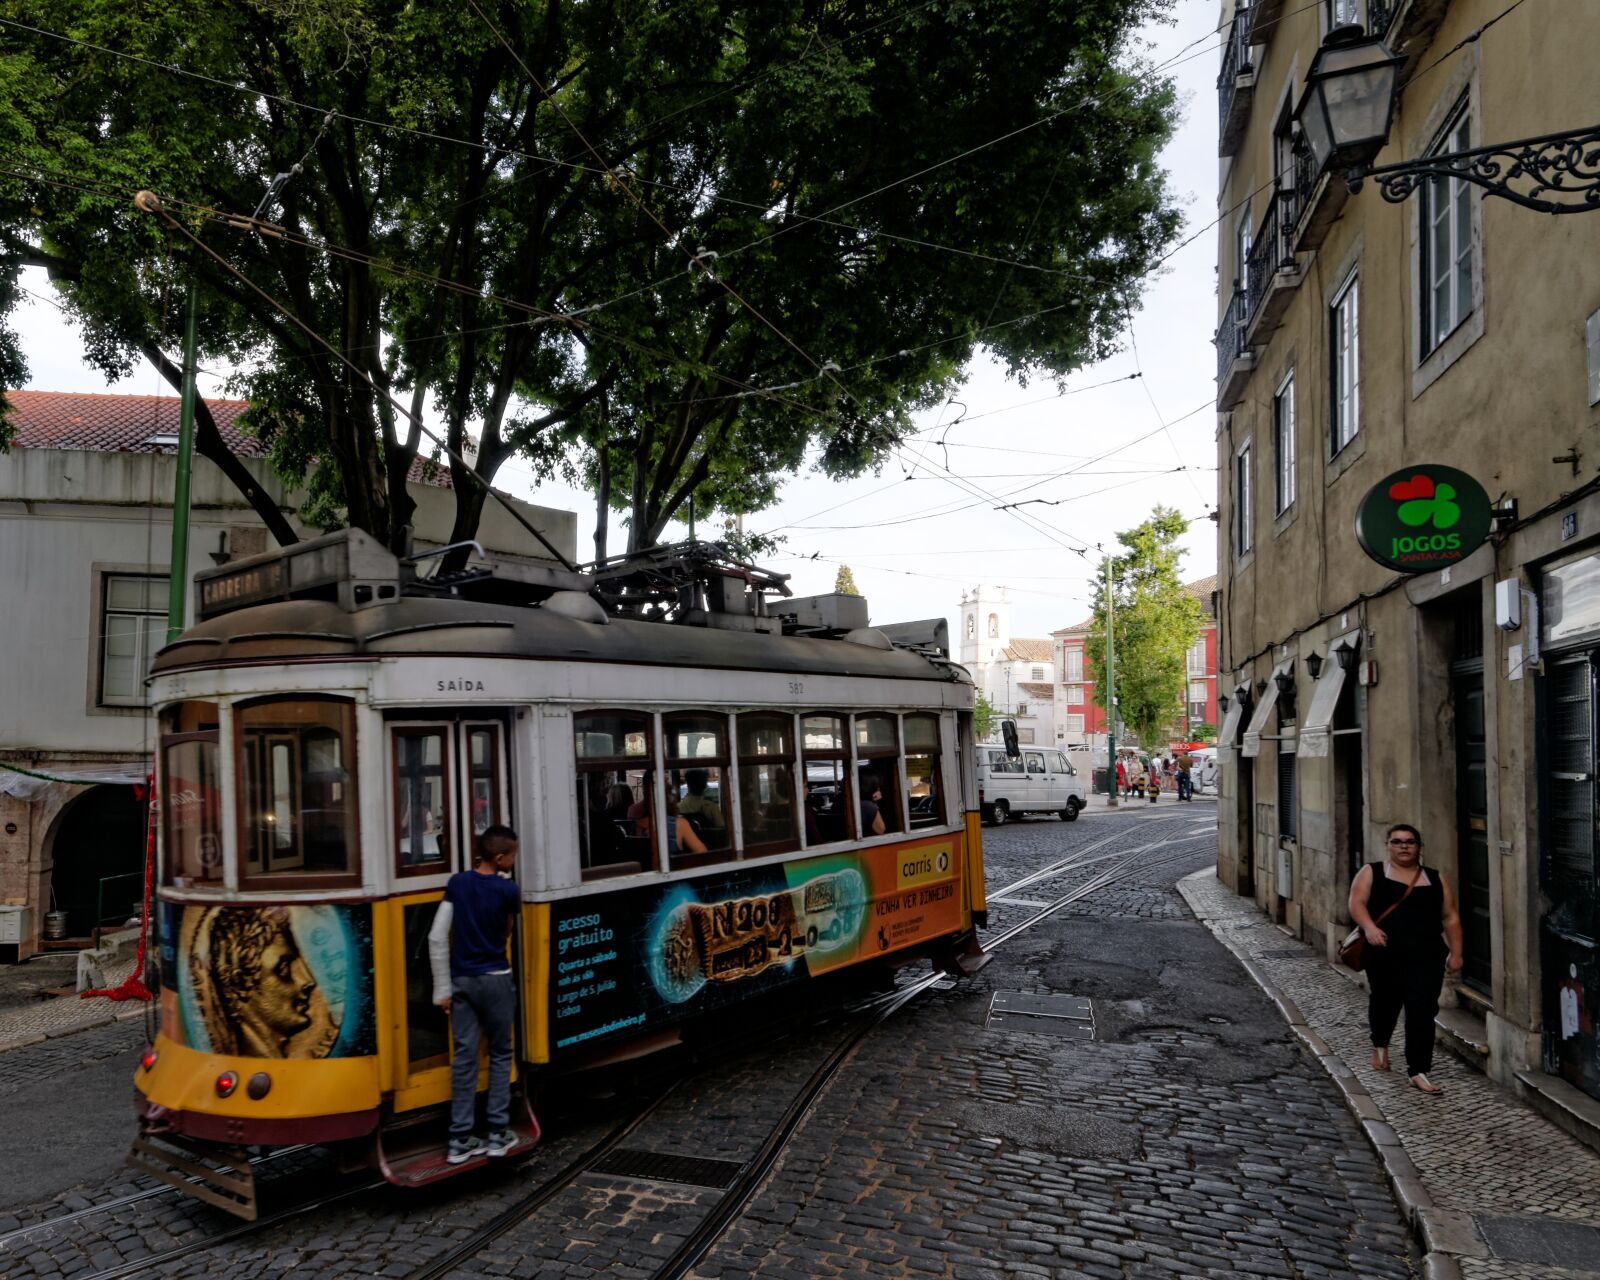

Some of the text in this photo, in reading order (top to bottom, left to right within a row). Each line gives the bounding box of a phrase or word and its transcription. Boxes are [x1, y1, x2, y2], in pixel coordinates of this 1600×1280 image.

[1391, 532, 1461, 559] JOGOS
[437, 677, 484, 692] SAÍDA
[788, 682, 804, 696] 582
[903, 855, 932, 877] carris
[876, 884, 954, 916] VENHA VER DINHEIRO
[558, 913, 601, 932] acesso
[558, 928, 614, 955] gratuito
[557, 1004, 582, 1019] Lisboa
